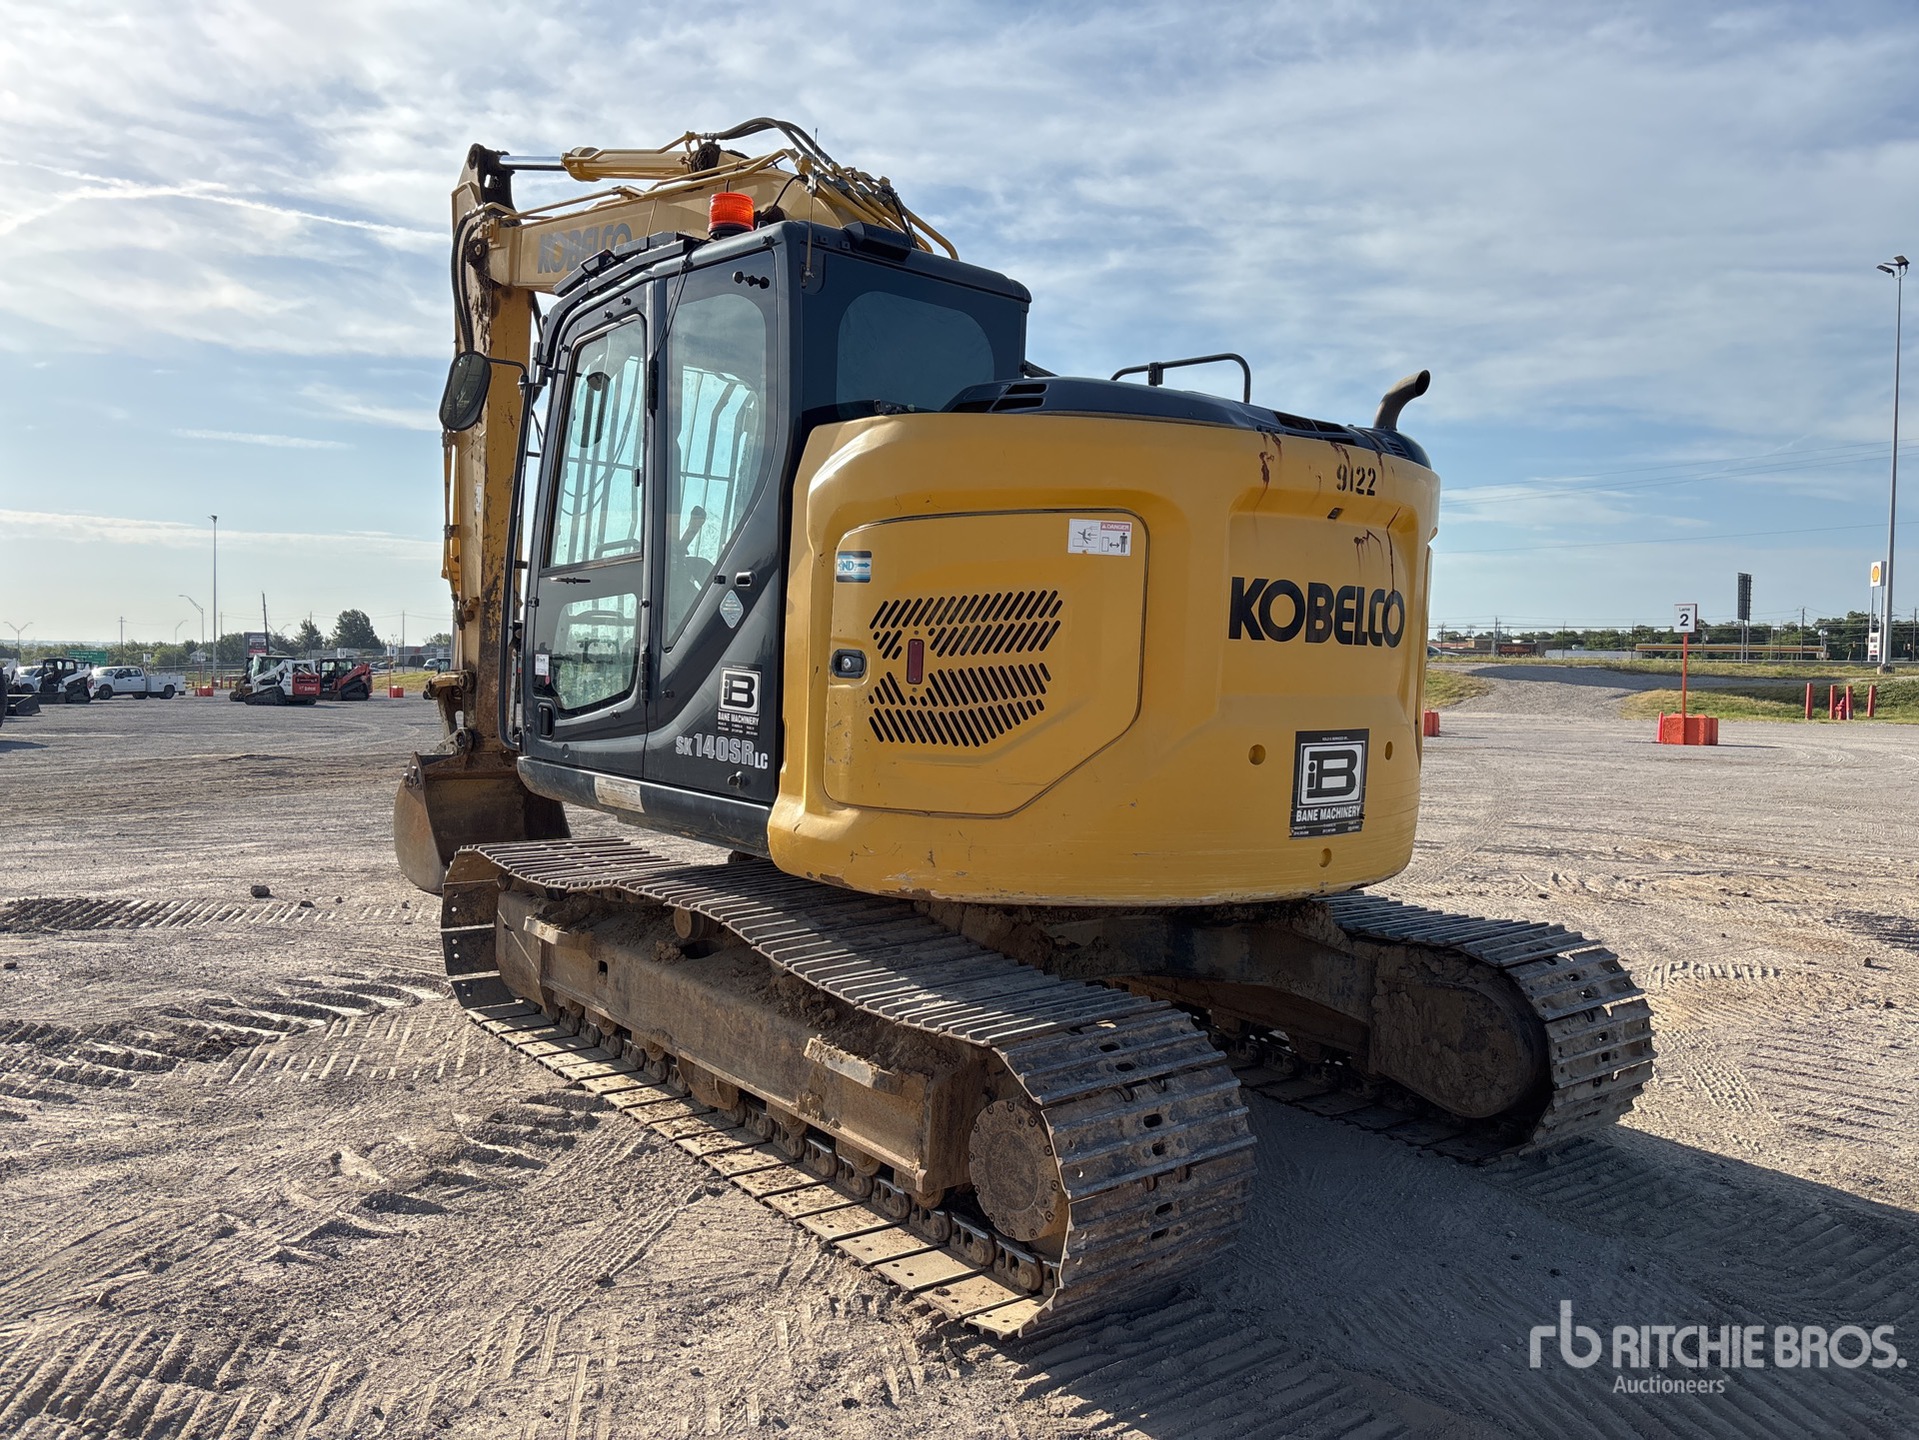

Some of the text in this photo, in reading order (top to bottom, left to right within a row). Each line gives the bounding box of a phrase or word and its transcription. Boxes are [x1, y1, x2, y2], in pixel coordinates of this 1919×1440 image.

[1336, 463, 1377, 496] 9122
[1228, 576, 1405, 648] KOBELCO
[1680, 613, 1689, 626] 2
[730, 714, 760, 726] MACHINERY
[1296, 805, 1361, 822] BANE MACHINERY
